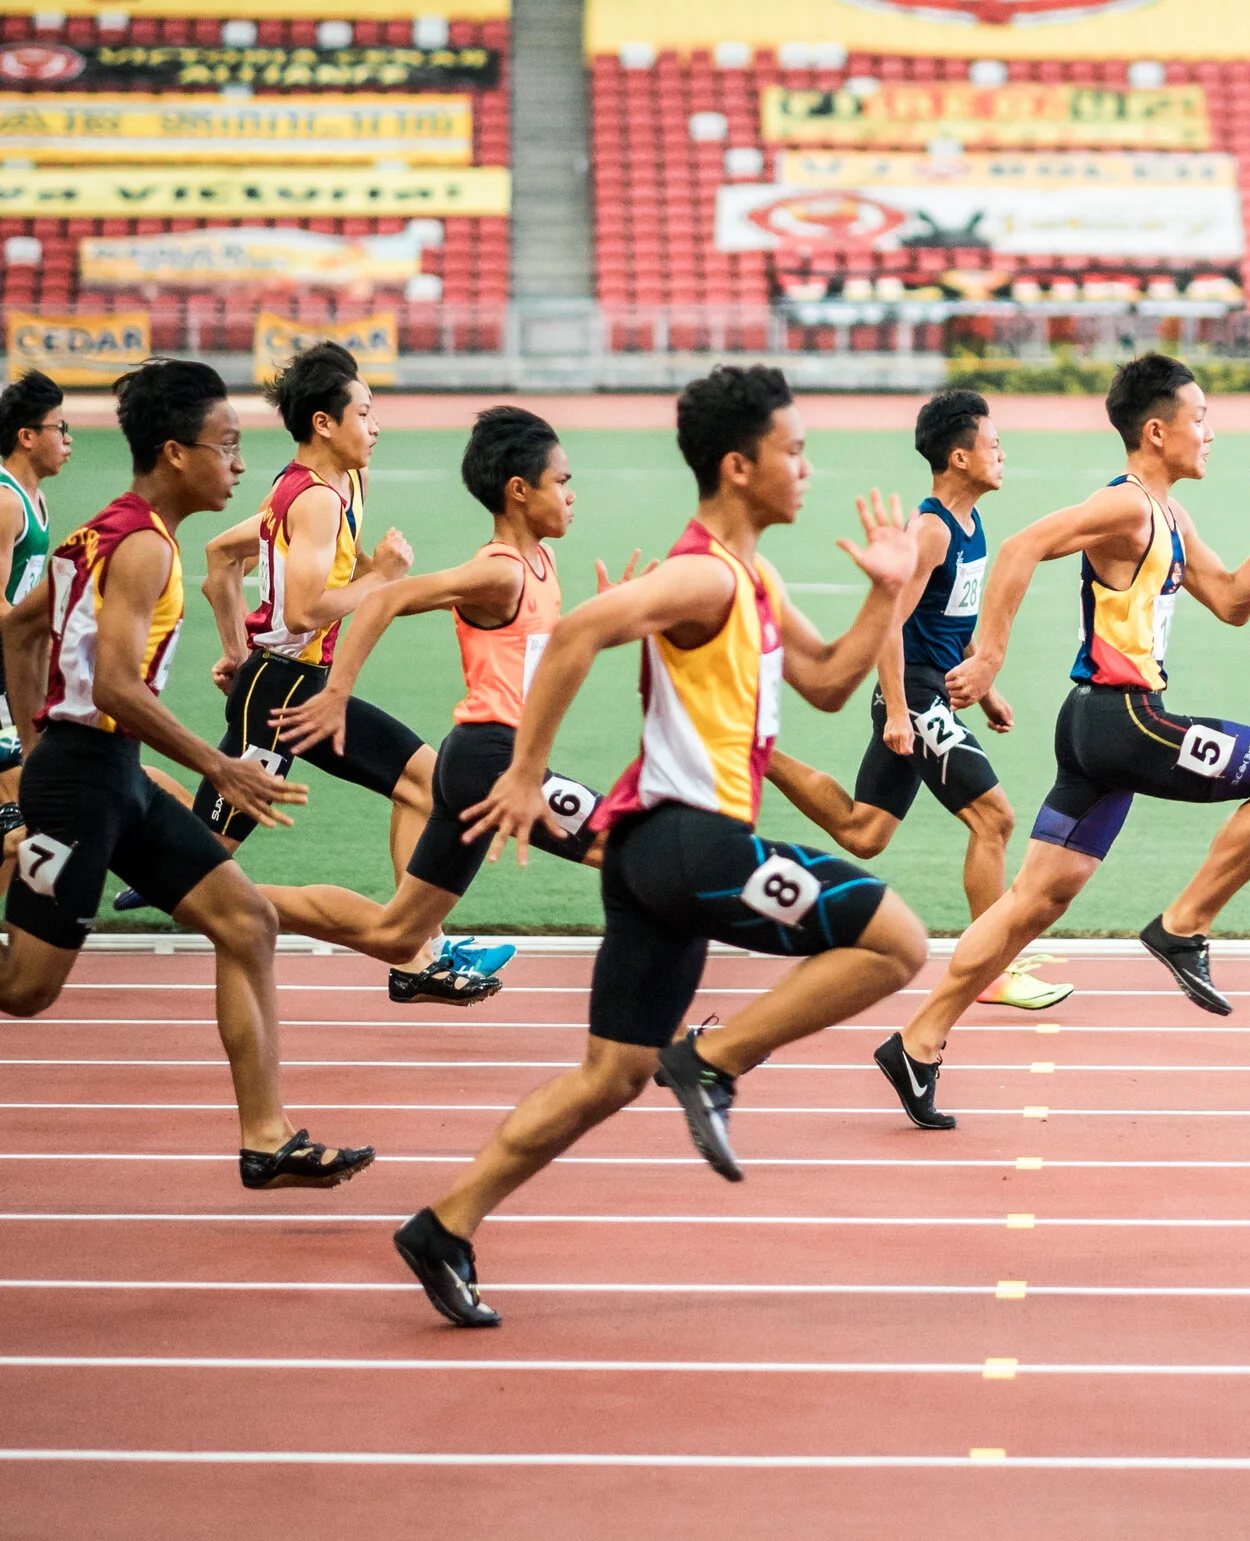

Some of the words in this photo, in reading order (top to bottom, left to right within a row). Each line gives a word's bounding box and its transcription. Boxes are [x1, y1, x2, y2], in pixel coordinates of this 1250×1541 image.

[15, 326, 145, 355] CEDAR
[925, 714, 954, 747] 2
[1190, 735, 1221, 766] 5
[548, 788, 582, 817] 6
[28, 842, 57, 880] 7
[762, 872, 803, 909] 8
